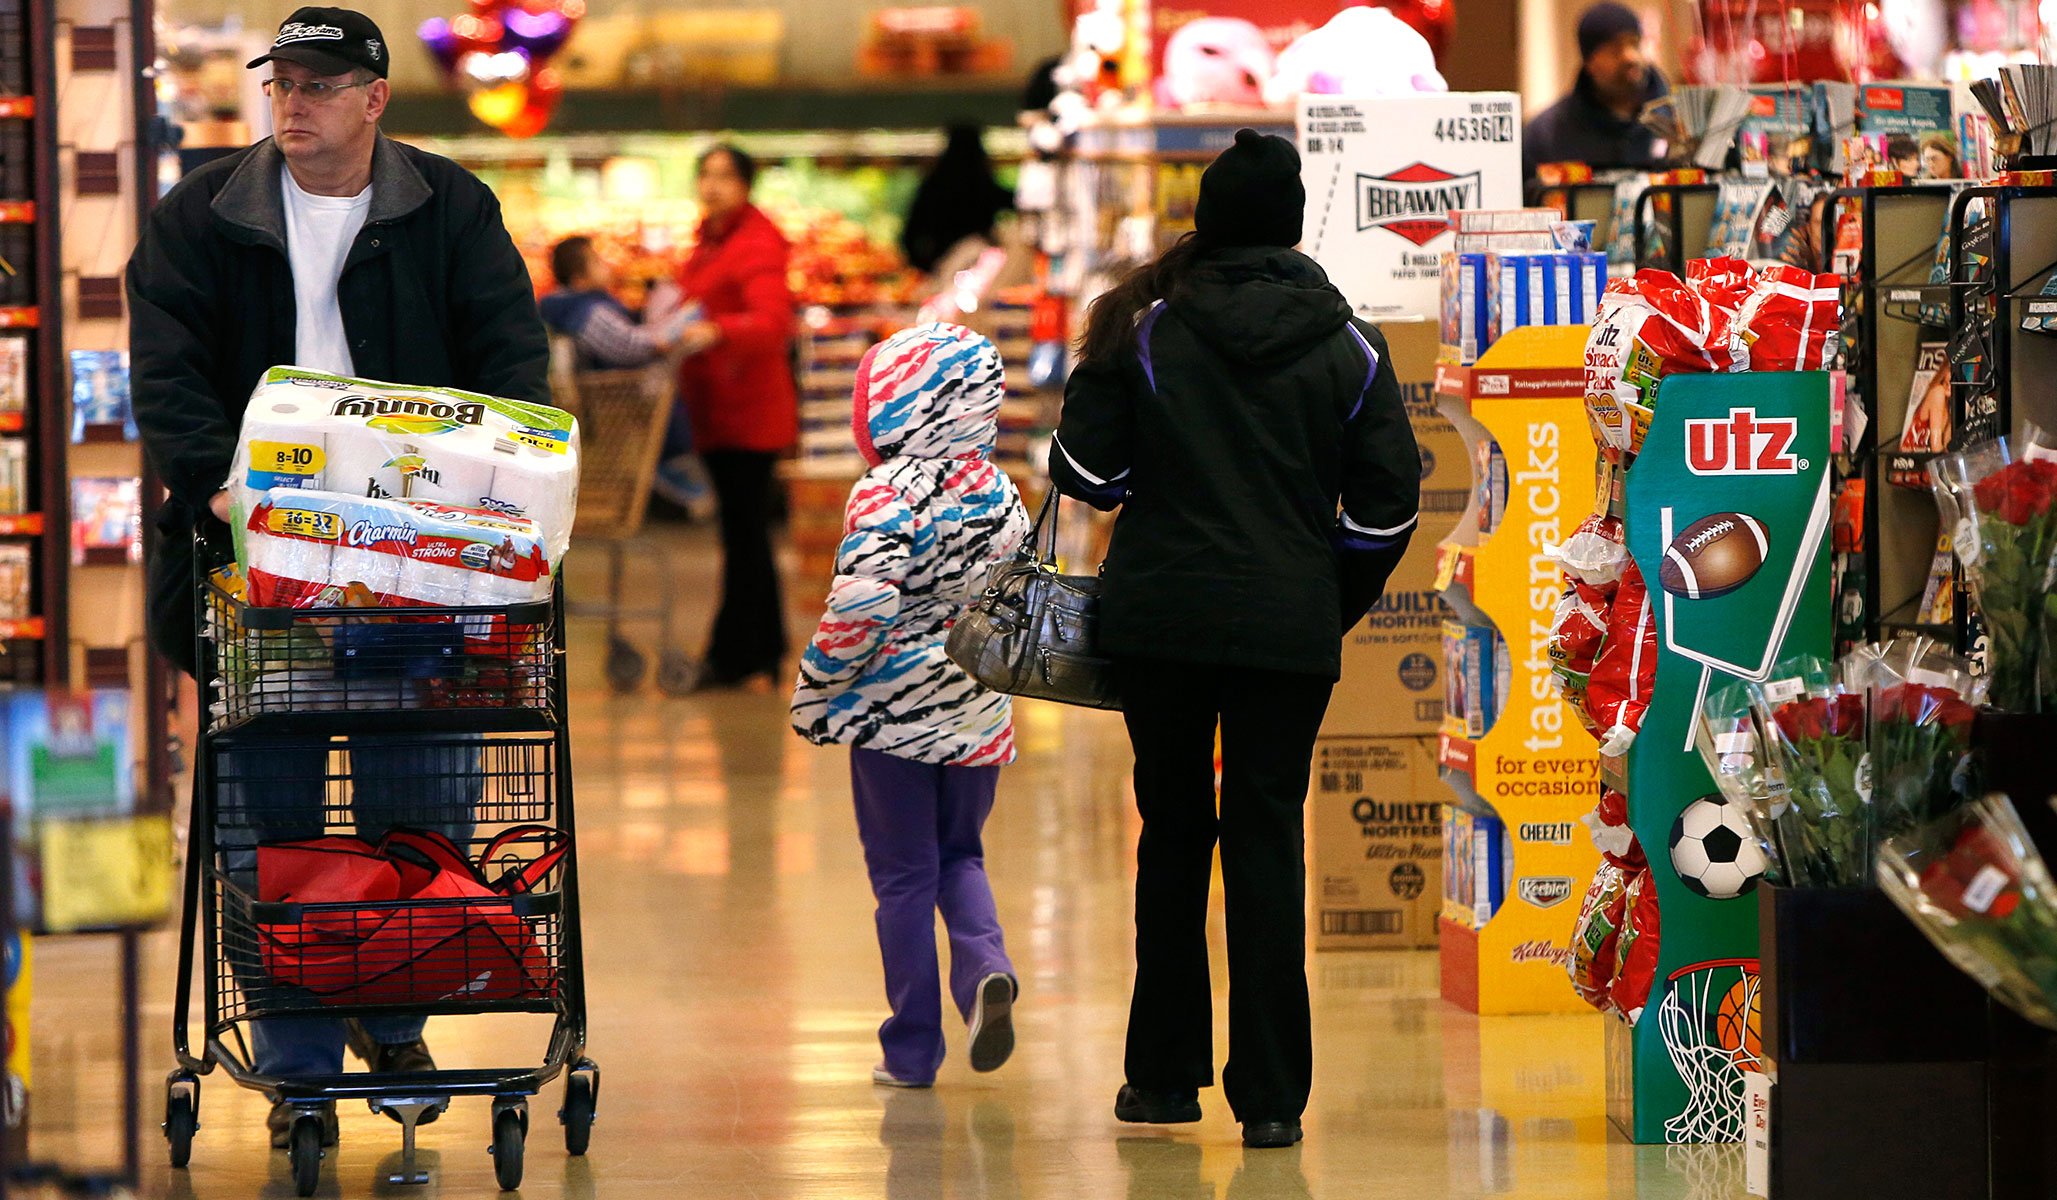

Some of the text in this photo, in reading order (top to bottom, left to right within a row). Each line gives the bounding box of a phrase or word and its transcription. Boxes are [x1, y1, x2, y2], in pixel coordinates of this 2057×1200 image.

[1367, 184, 1469, 220] BRAWNY
[1585, 369, 1616, 390] Pack
[331, 395, 485, 425] Bounty
[276, 447, 312, 466] 8=10
[285, 511, 333, 530] 16=32
[348, 520, 418, 547] Charmin
[412, 547, 457, 559] STRONG
[1516, 421, 1563, 752] tasty snacks
[1369, 614, 1457, 628] NORTHE
[1496, 755, 1600, 778] for every
[1496, 776, 1600, 796] occasion
[1522, 879, 1567, 899] Keebler
